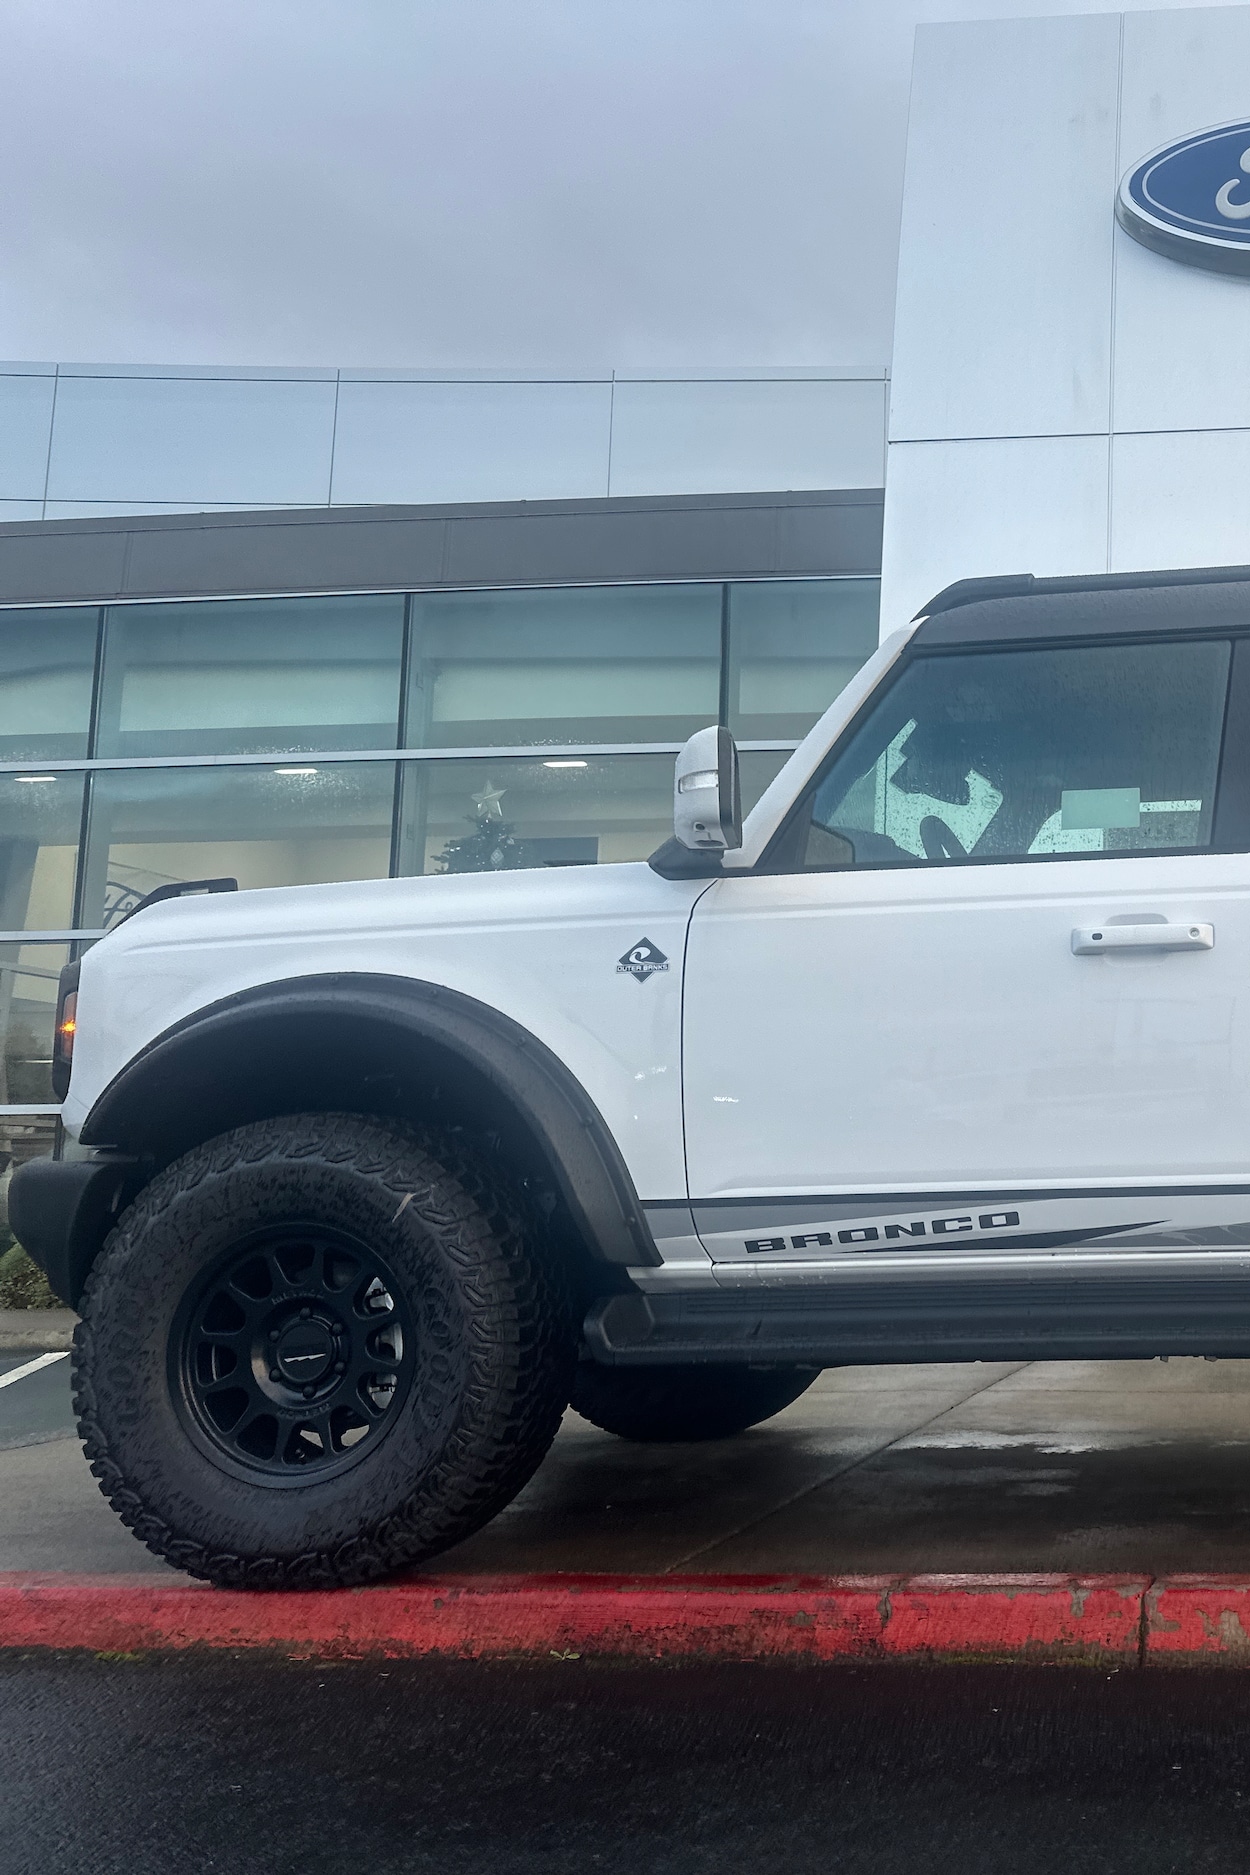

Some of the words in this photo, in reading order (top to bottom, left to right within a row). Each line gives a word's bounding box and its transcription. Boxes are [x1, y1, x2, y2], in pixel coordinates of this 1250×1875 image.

[617, 964, 642, 972] OUTER
[643, 963, 668, 971] BANKS
[744, 1211, 1020, 1254] BRONCO
